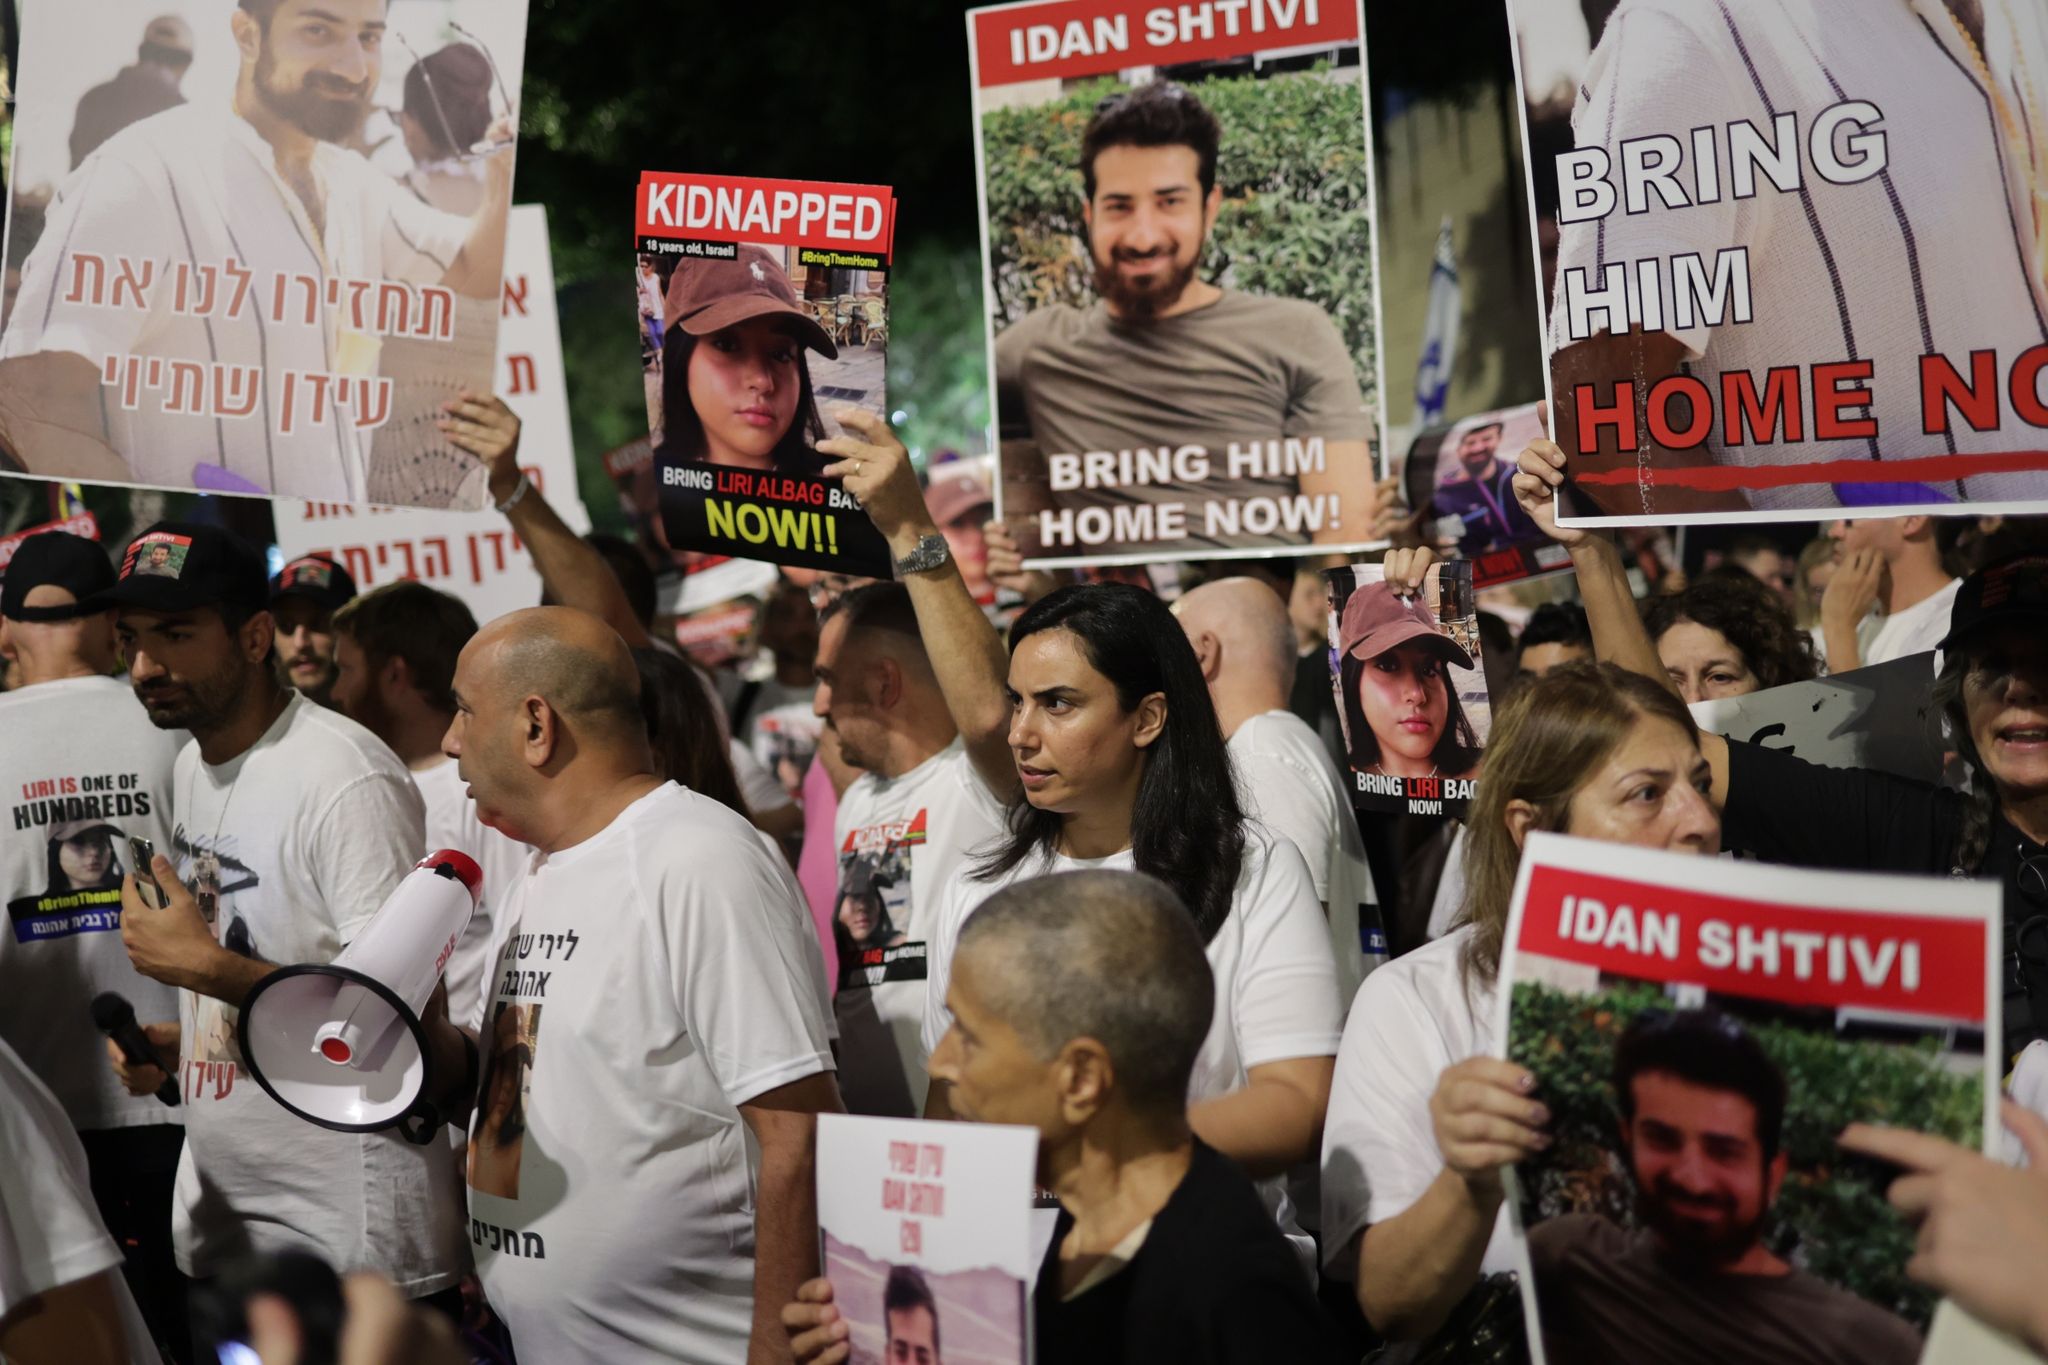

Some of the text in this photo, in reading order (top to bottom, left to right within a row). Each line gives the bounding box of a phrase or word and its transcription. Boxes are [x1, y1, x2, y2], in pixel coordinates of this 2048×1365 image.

[1010, 0, 1320, 66] IDAN SHTIVI
[1554, 99, 1889, 225] BRING
[647, 182, 883, 241] KIDNAPPED
[646, 239, 735, 257] 18 years old, Israeli
[801, 251, 879, 269] #BringThemHome
[64, 253, 153, 311] את
[172, 257, 254, 319] לנו
[271, 273, 455, 339] תחזירו
[1564, 246, 1753, 340] HIM
[103, 355, 391, 434] עידן שתיוי
[1573, 359, 1879, 456] HOME
[662, 466, 714, 490] BRING
[718, 471, 753, 496] LIRI
[756, 476, 825, 505] ALBAG
[1048, 437, 1327, 491] BRING HIM
[704, 498, 838, 555] NOW!!
[1039, 494, 1341, 547] HOME NOW!
[306, 537, 450, 585] הבית
[12, 792, 152, 830] HUNDREDS
[22, 774, 139, 800] LIRI IS ONE OF
[1356, 772, 1479, 800] BRING LIRI BAC
[1408, 799, 1442, 815] NOW!
[538, 929, 579, 961] לירי
[1557, 895, 1921, 992] IDAN SHTIVI
[500, 971, 552, 997] אהובה
[185, 1060, 236, 1106] עידן
[472, 1217, 546, 1260] מחכים
